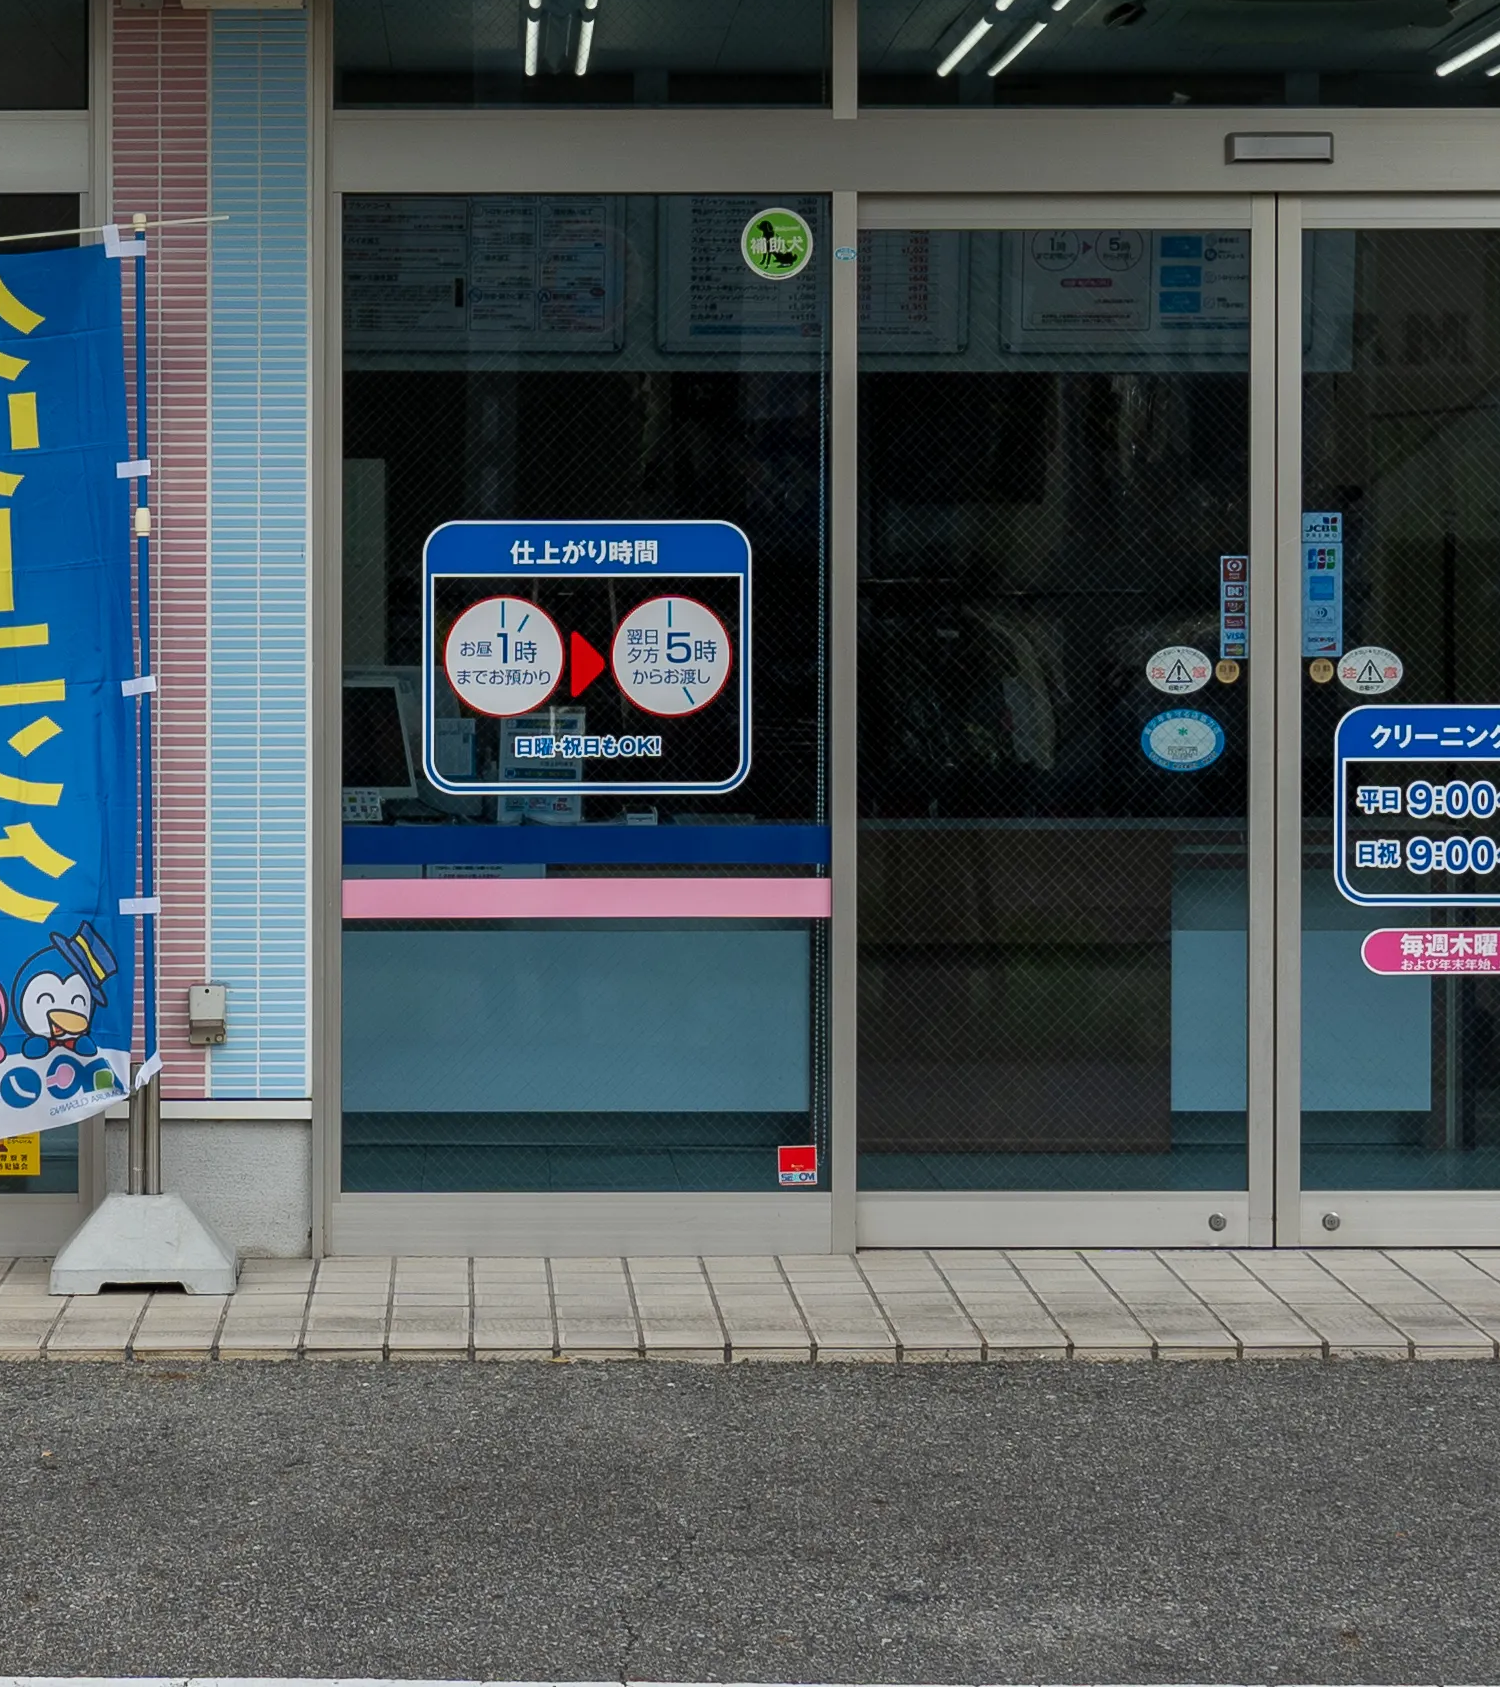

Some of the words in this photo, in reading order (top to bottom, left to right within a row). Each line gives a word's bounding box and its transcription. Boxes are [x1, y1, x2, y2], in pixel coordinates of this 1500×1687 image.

[750, 235, 805, 254] 補助犬
[1304, 524, 1331, 533] JCB
[510, 539, 659, 565] 仕上がり時間
[626, 628, 660, 645] 翌日
[1226, 632, 1245, 640] VISA
[626, 646, 660, 664] 夕方
[456, 668, 552, 686] までお預かり
[632, 668, 711, 685] からお渡し
[1357, 785, 1402, 815] 平日
[1356, 838, 1401, 869] 日祝
[1399, 932, 1499, 958] 毎週木曜
